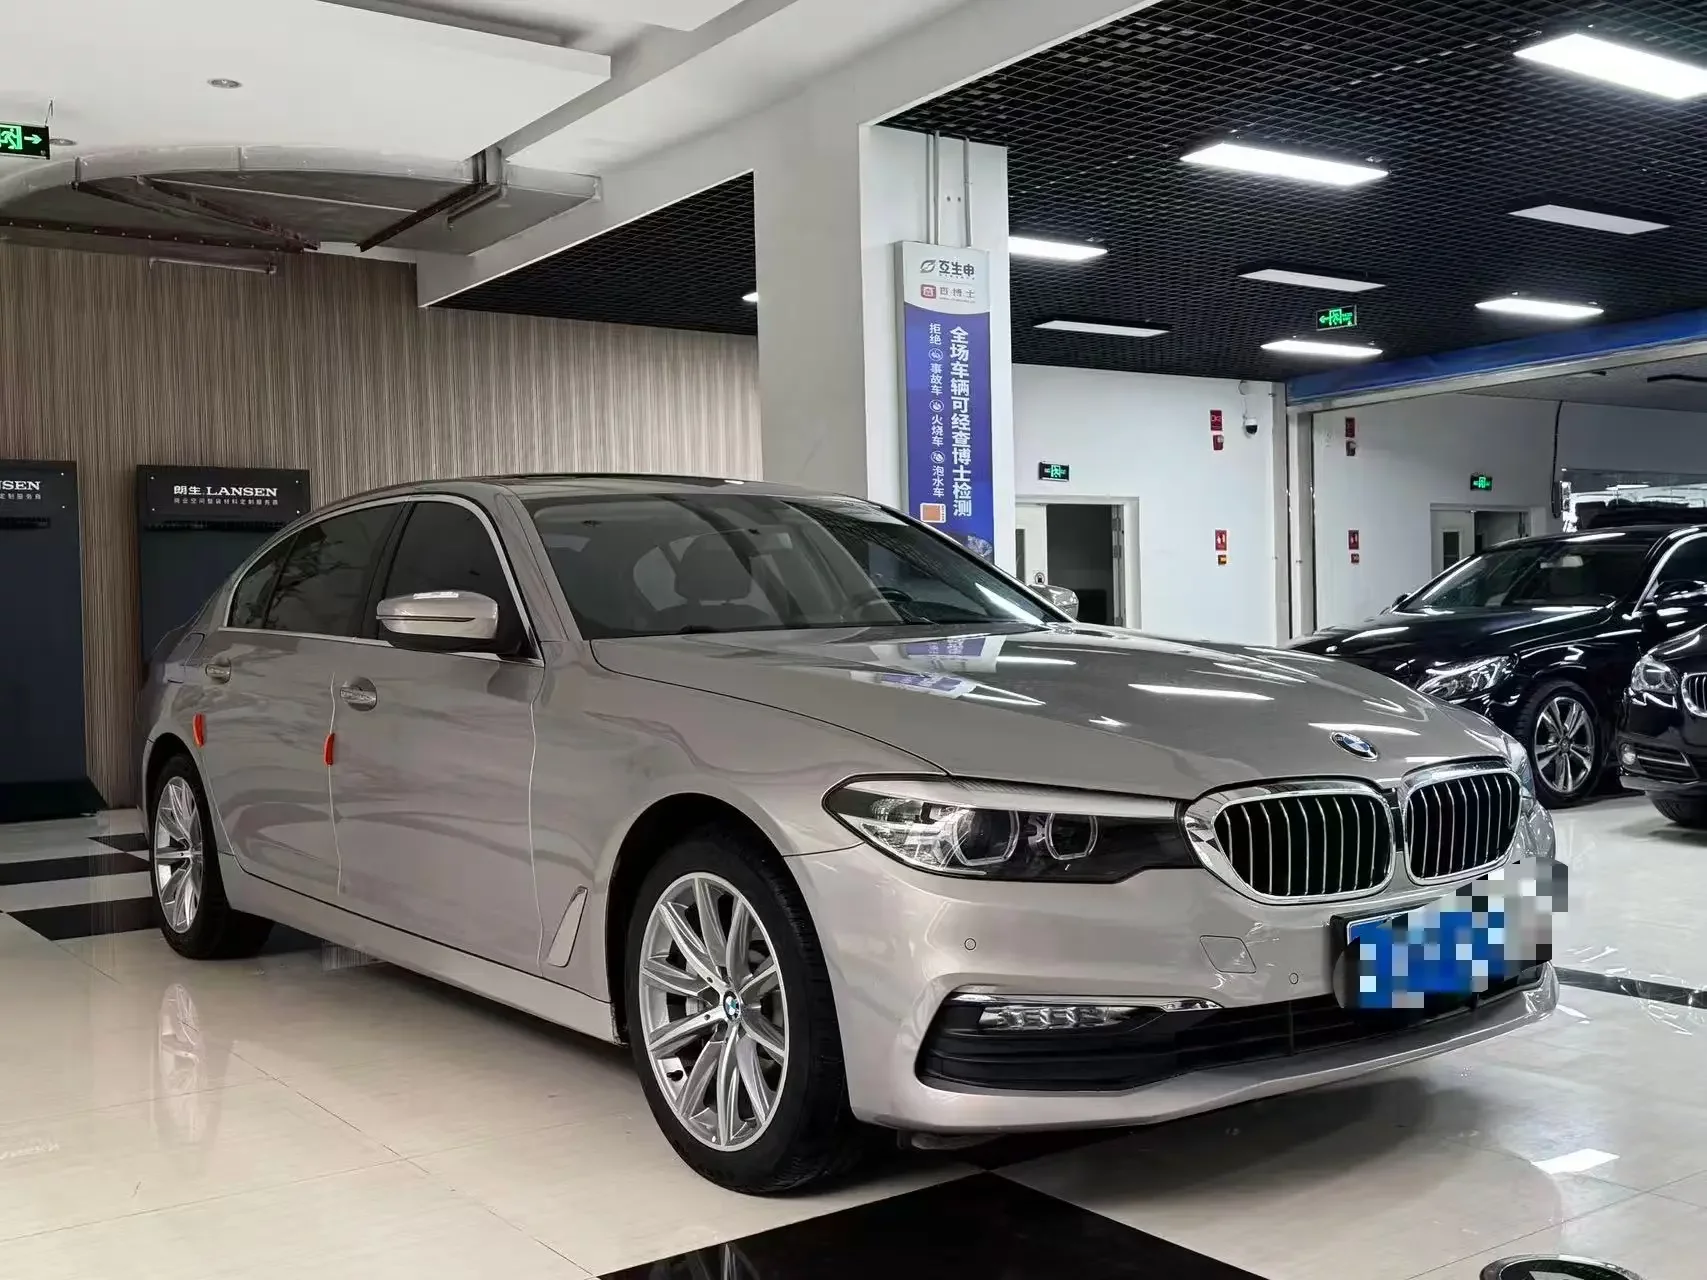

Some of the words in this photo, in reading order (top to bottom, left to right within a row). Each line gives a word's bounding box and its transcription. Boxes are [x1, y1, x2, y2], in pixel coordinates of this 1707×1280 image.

[929, 322, 942, 345] 拒绝
[930, 362, 943, 396] 事故车
[931, 414, 944, 446] 火烧车
[949, 326, 972, 517] 全场车辆可经查博士检测
[0, 480, 41, 491] SEN
[173, 485, 201, 496] 朗生
[206, 486, 278, 497] LANSEN
[932, 465, 945, 497] 泡水车
